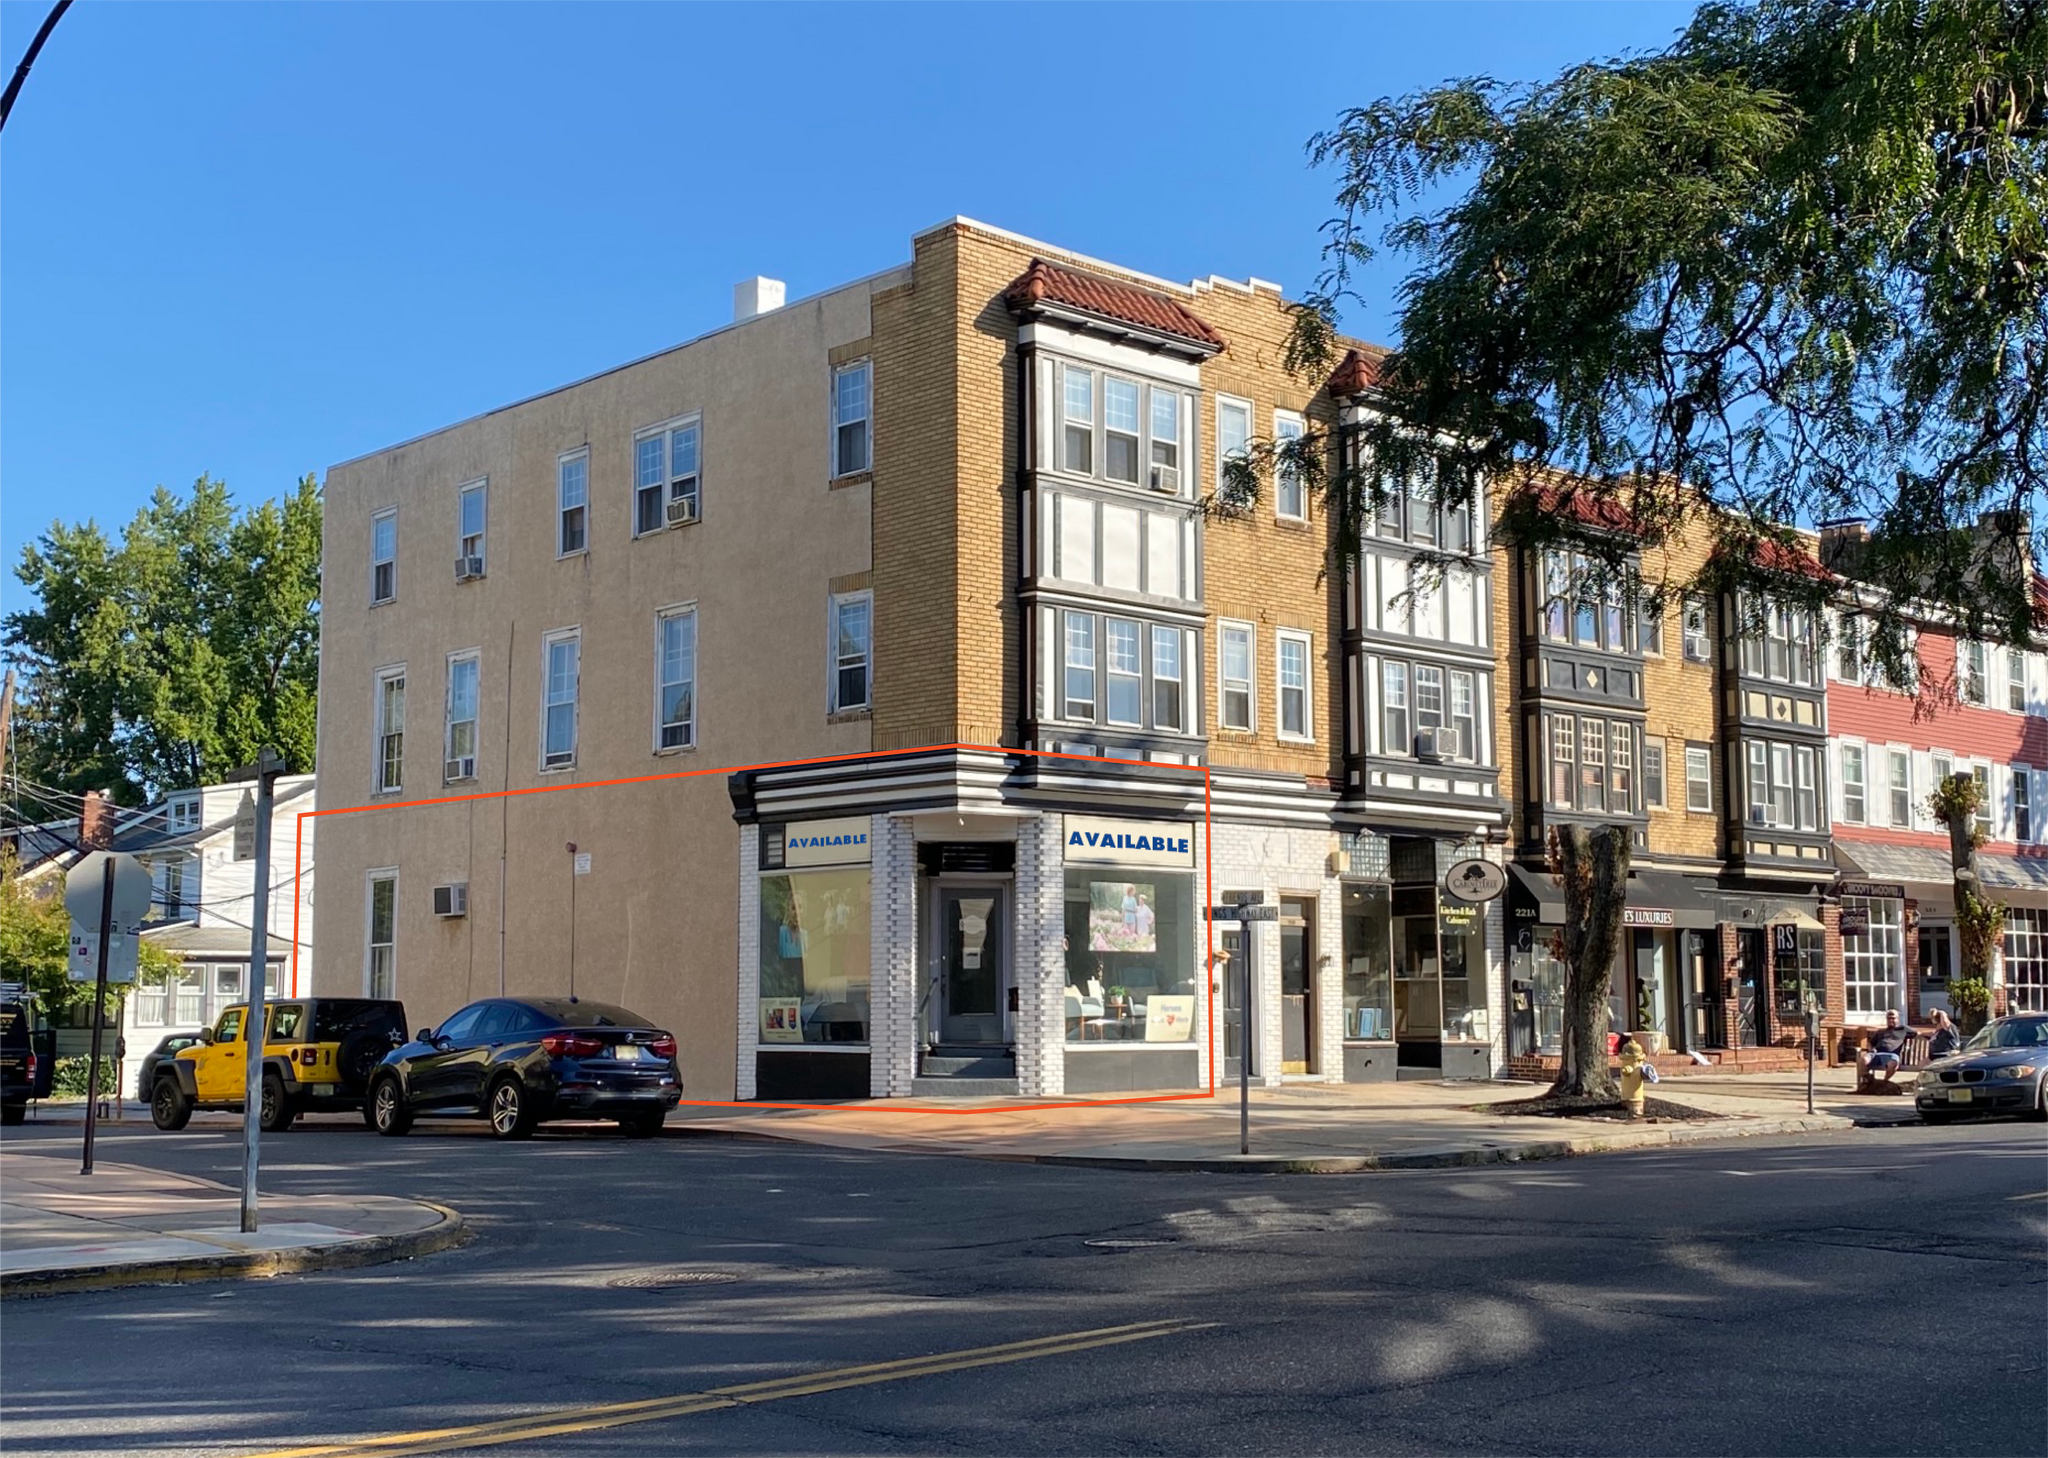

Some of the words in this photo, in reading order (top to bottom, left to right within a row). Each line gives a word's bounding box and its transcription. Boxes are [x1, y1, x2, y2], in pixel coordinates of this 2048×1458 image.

[788, 834, 867, 848] AVAILABLE
[1068, 831, 1189, 853] AVAILABLE
[1515, 908, 1537, 917] 221A
[1635, 911, 1672, 924] LUXURIES
[1777, 925, 1794, 950] RS
